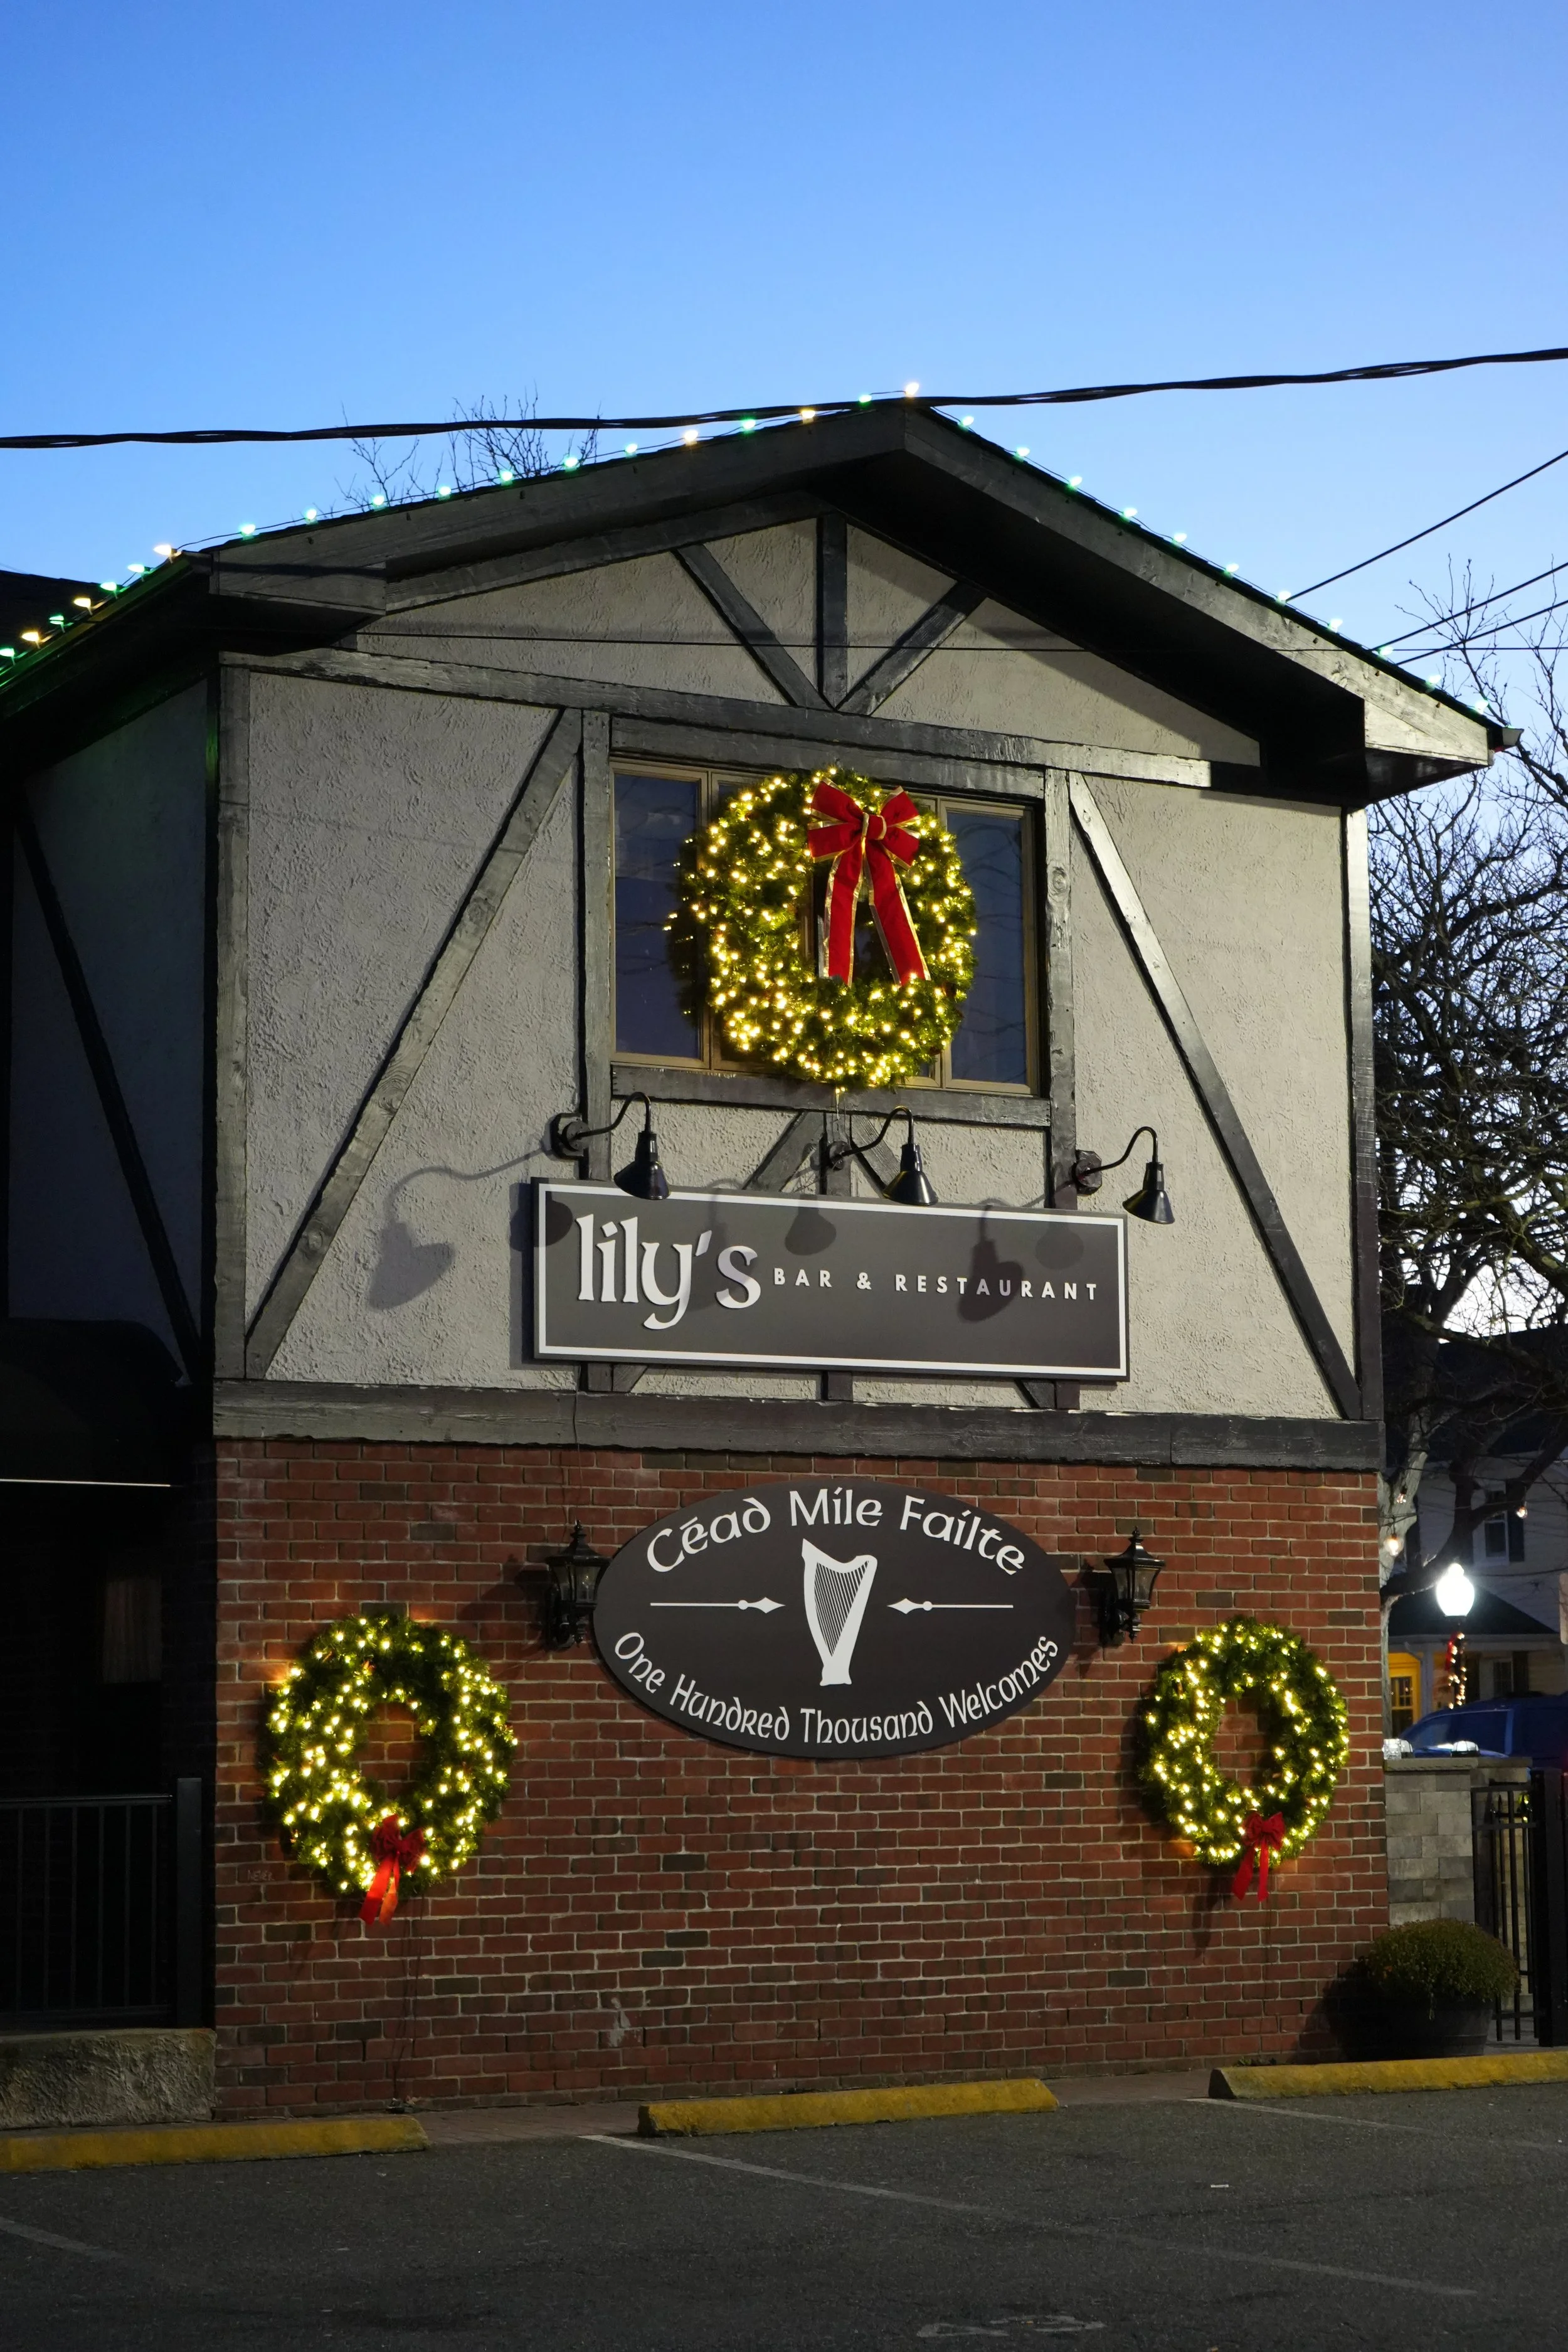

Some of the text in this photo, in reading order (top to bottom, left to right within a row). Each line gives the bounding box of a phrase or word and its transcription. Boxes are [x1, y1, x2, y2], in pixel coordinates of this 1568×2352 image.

[575, 1213, 1097, 1330] lily's BAR & RESTAURANT
[615, 1632, 1058, 1744] One Hundred Thousand Welcomes
